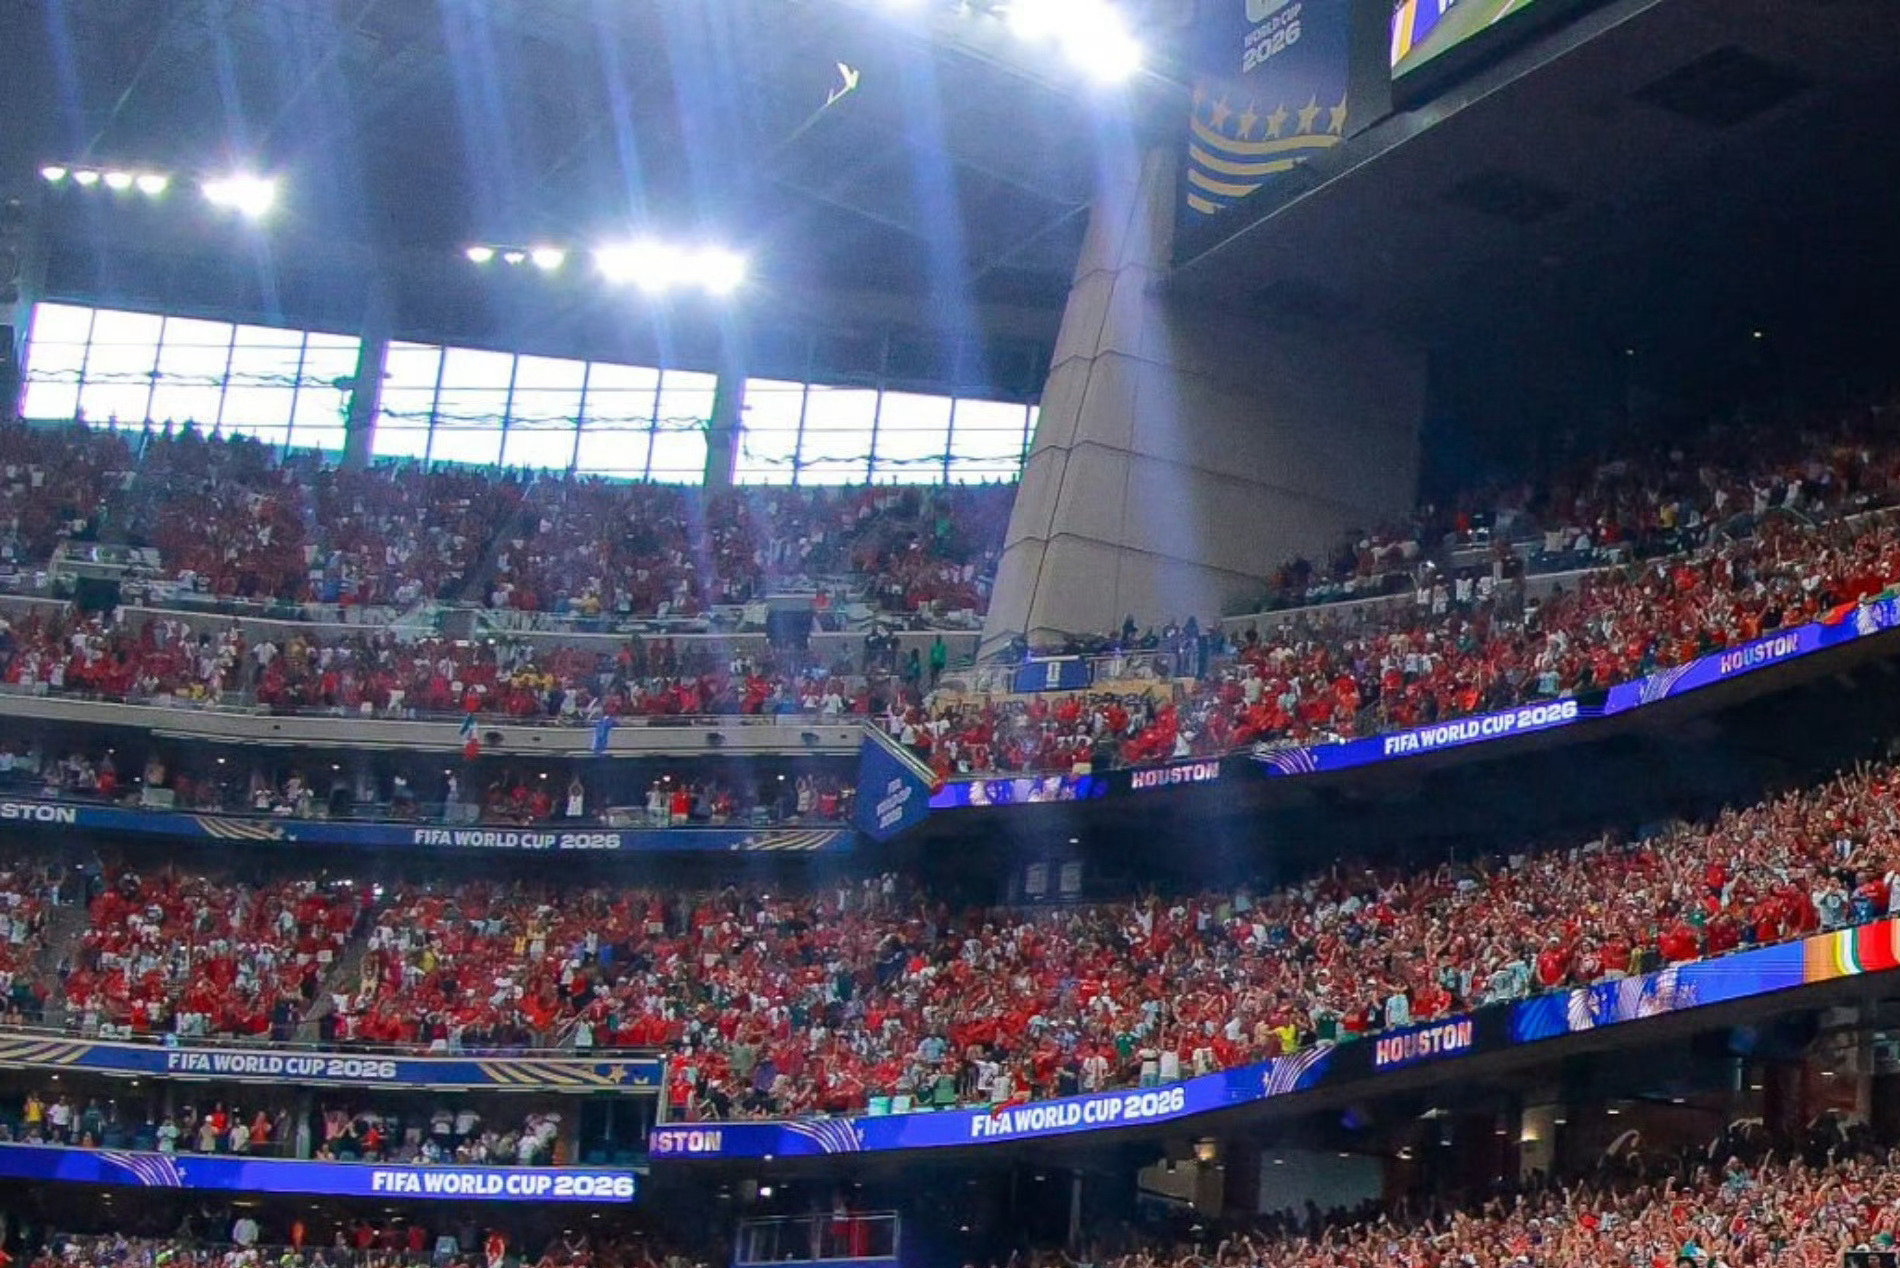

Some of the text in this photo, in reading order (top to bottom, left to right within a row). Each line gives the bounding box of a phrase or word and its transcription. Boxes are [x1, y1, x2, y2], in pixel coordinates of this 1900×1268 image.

[1243, 20, 1302, 73] 2026
[1721, 632, 1798, 674] HOUSTON
[1384, 700, 1578, 754] FIFA WORLD CUP 2026
[1131, 762, 1220, 789] HOUSTON
[414, 829, 621, 850] FIFA WORLD CUP 2026
[1375, 1020, 1472, 1065] HOUSTON
[168, 1053, 397, 1079] FIFA WORLD CUP 2026
[971, 1087, 1185, 1137] FIFA WORLD CUP 2026
[372, 1171, 635, 1197] FIFA WORLD CUP 2026
